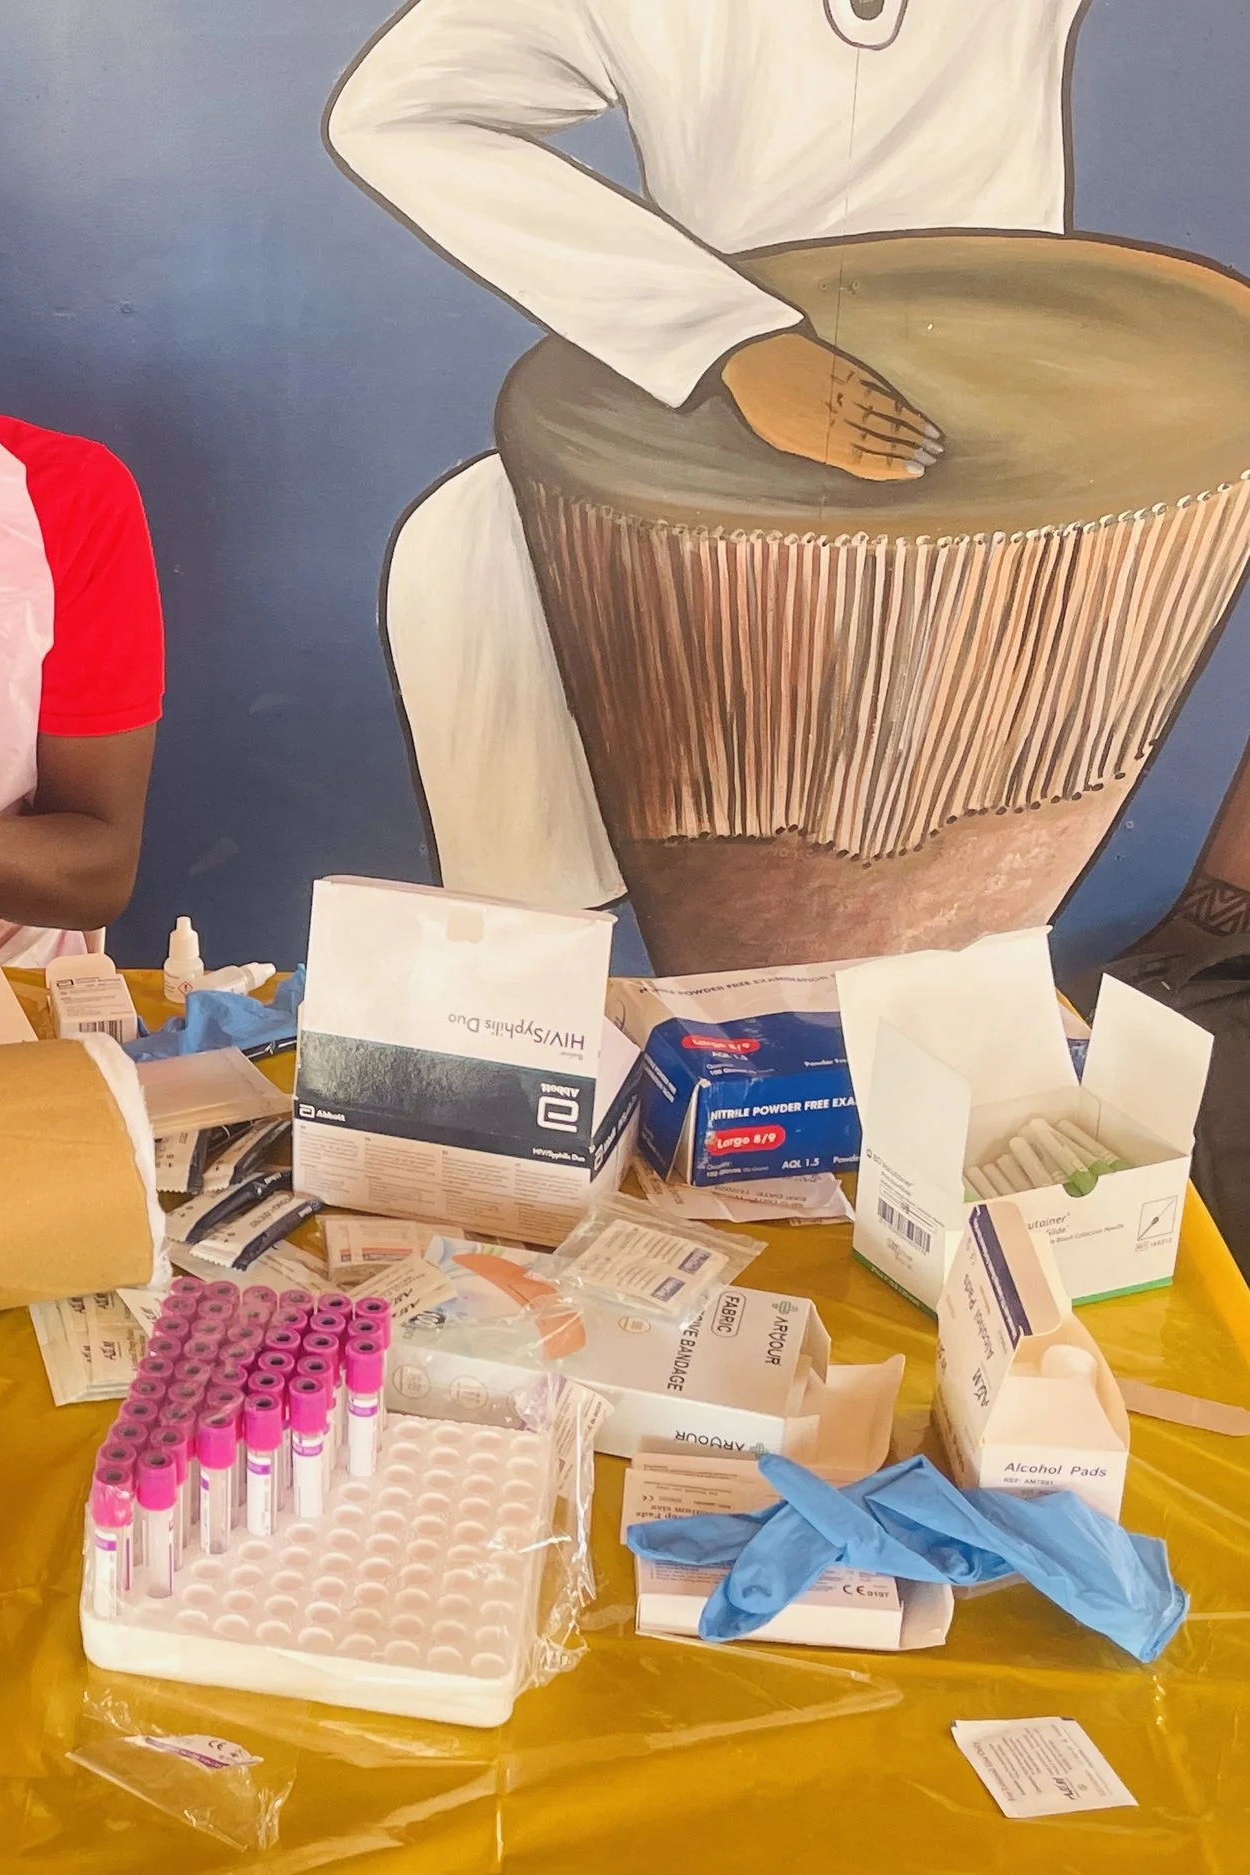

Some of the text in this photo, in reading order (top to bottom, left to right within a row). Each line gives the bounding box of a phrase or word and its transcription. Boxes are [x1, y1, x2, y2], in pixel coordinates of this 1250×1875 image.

[448, 1013, 584, 1050] HIV/Syphilis Duo
[541, 1083, 579, 1097] Abbott
[316, 1110, 346, 1123] Abbott
[710, 1096, 857, 1121] NITRILE POWDER FREE EXA
[717, 1133, 777, 1149] Large 8/9
[782, 1159, 802, 1170] AQL
[806, 1158, 820, 1167] 1.5
[1028, 1212, 1069, 1230] utainer
[717, 1295, 740, 1334] FABRIC
[666, 1339, 696, 1392] BANDAGE
[1004, 1462, 1107, 1477] Alcohol Pads
